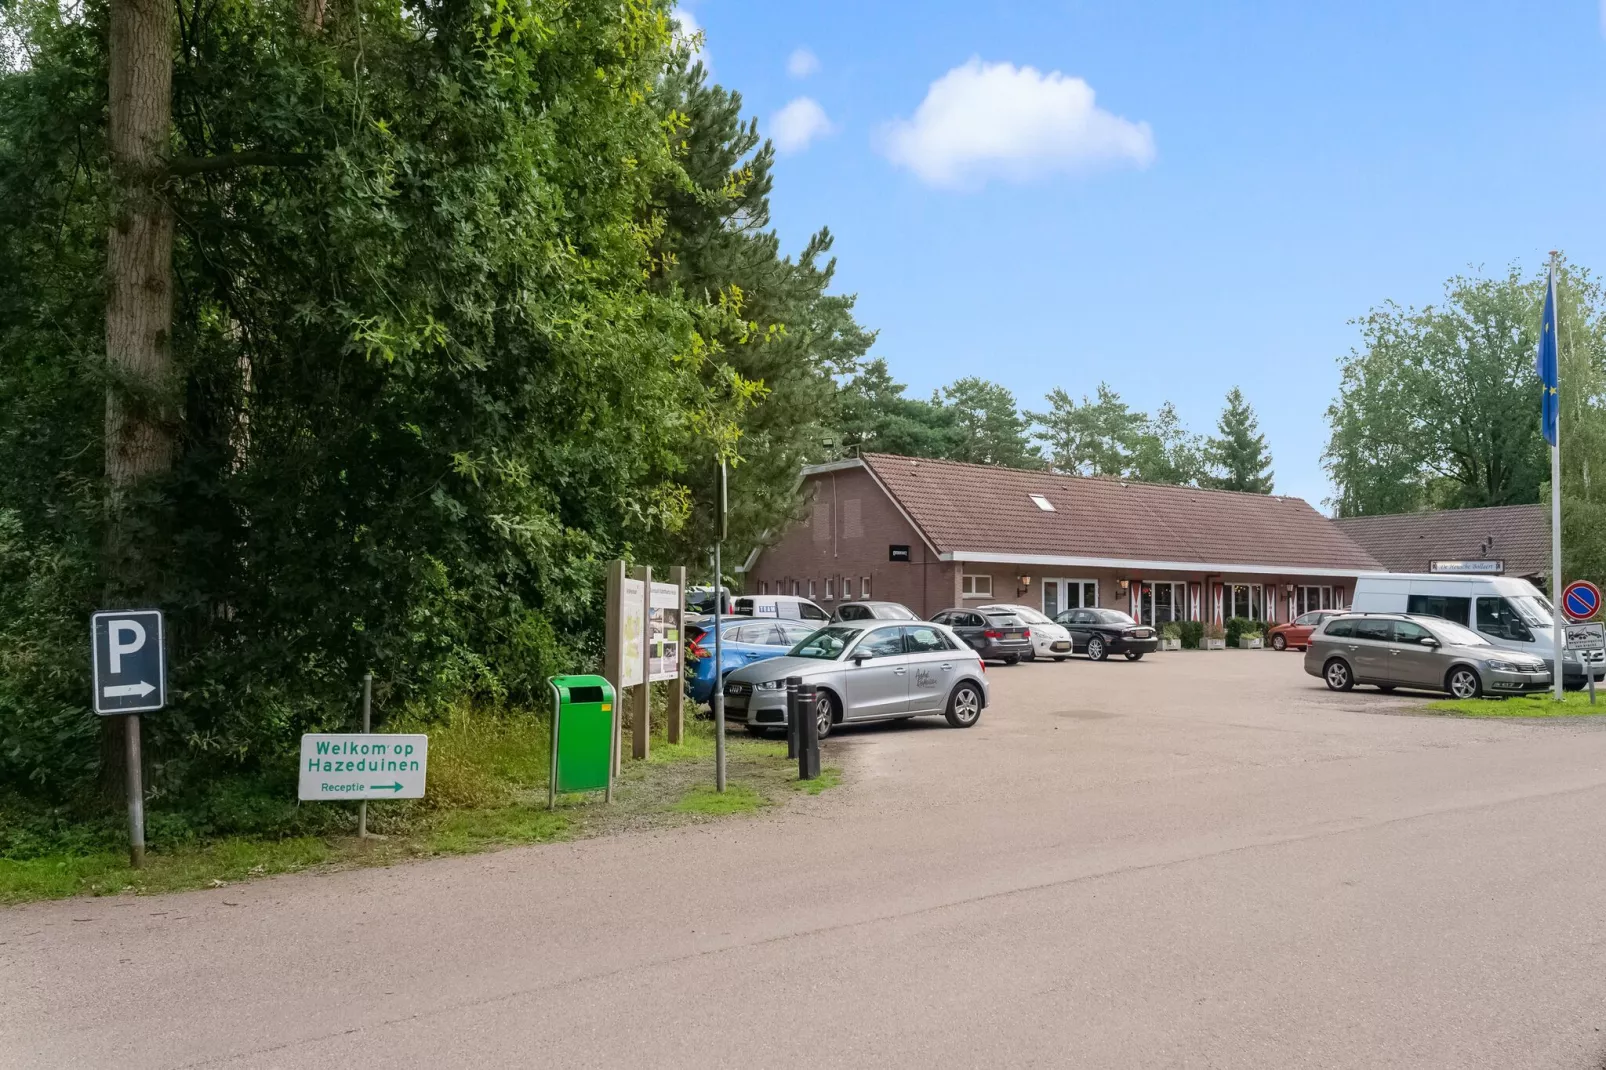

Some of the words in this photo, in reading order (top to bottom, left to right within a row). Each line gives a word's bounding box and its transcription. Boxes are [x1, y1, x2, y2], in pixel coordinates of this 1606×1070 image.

[108, 619, 146, 673] P
[316, 741, 386, 755] Welkom
[394, 744, 414, 757] op
[308, 758, 419, 772] Hazeduinen
[321, 783, 365, 792] Receptie
